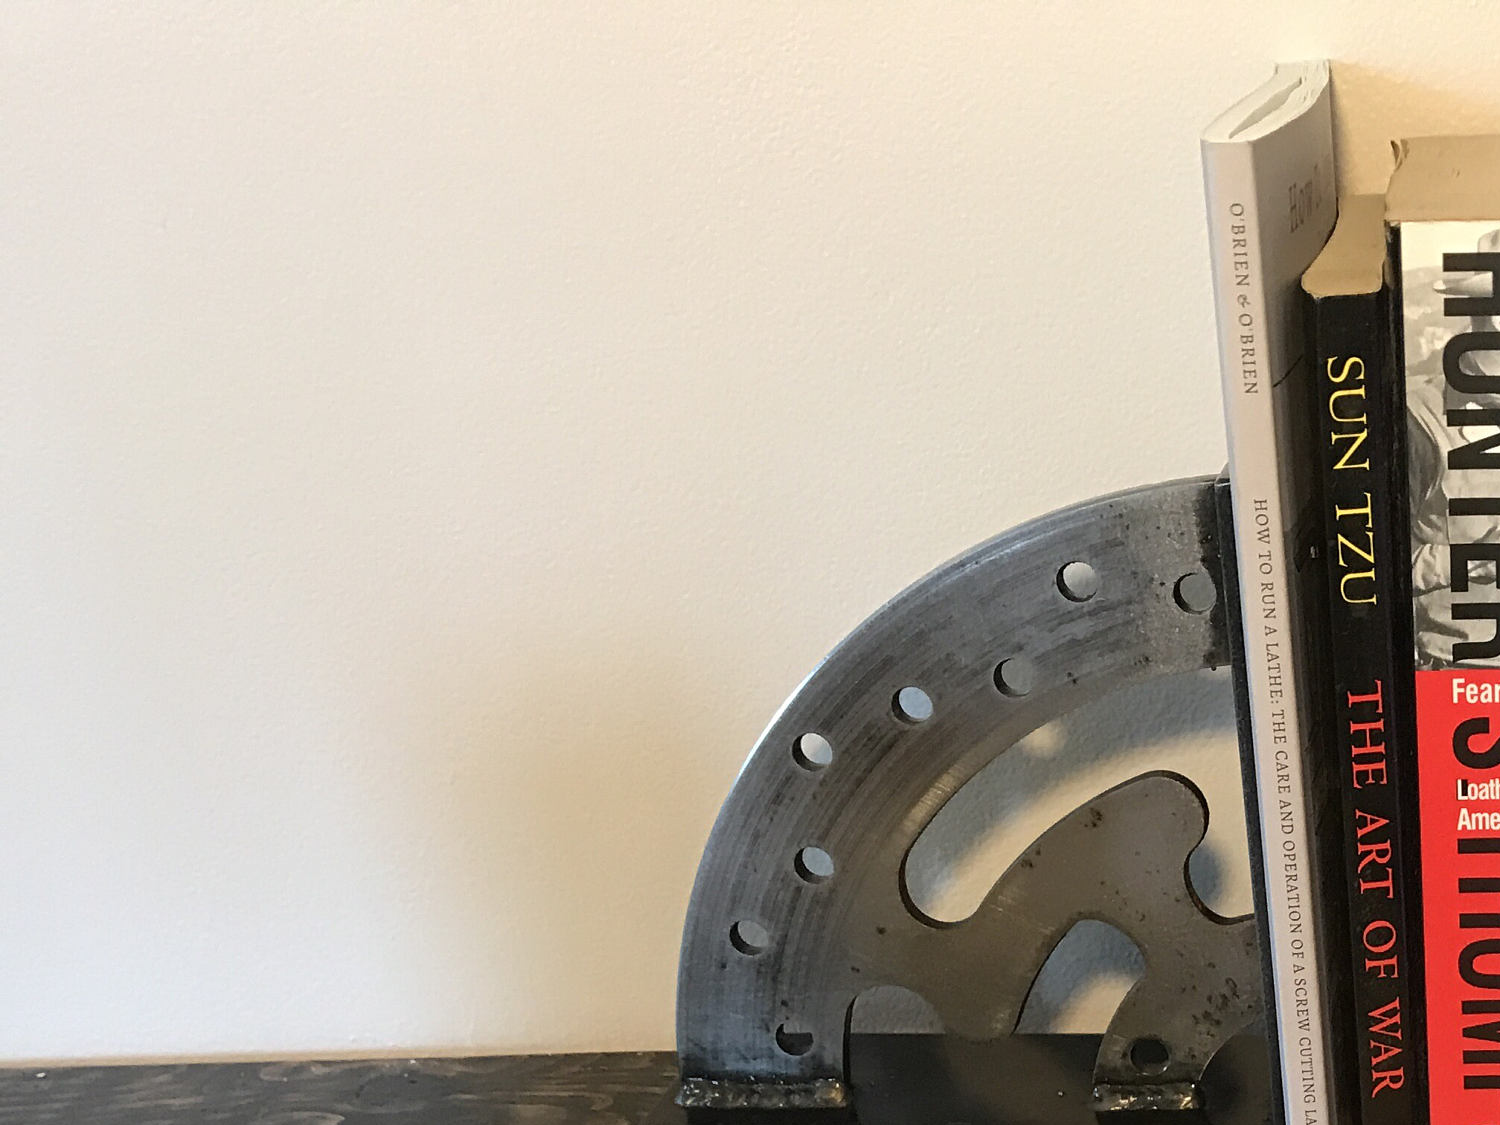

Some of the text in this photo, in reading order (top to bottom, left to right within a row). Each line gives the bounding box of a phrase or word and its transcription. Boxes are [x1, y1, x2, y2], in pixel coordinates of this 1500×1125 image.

[1230, 203, 1258, 395] O'BRIEN & O'BRIEN
[1327, 356, 1377, 605] SUN TZU
[1253, 499, 1271, 545] HOW
[1258, 551, 1273, 575] TO
[1261, 582, 1276, 619] RUN
[1264, 625, 1278, 637] A
[1266, 642, 1283, 704] LATHE:
[1272, 709, 1287, 745] THE
[1275, 750, 1291, 794] CARE
[1279, 800, 1294, 835] AND
[1282, 840, 1303, 934] OPERATION
[1347, 680, 1404, 1099] THE ART OF WAR
[1291, 939, 1305, 960] OF
[1293, 963, 1305, 974] A
[1294, 978, 1310, 1032] SCREW
[1299, 1037, 1316, 1104] CUTTING
